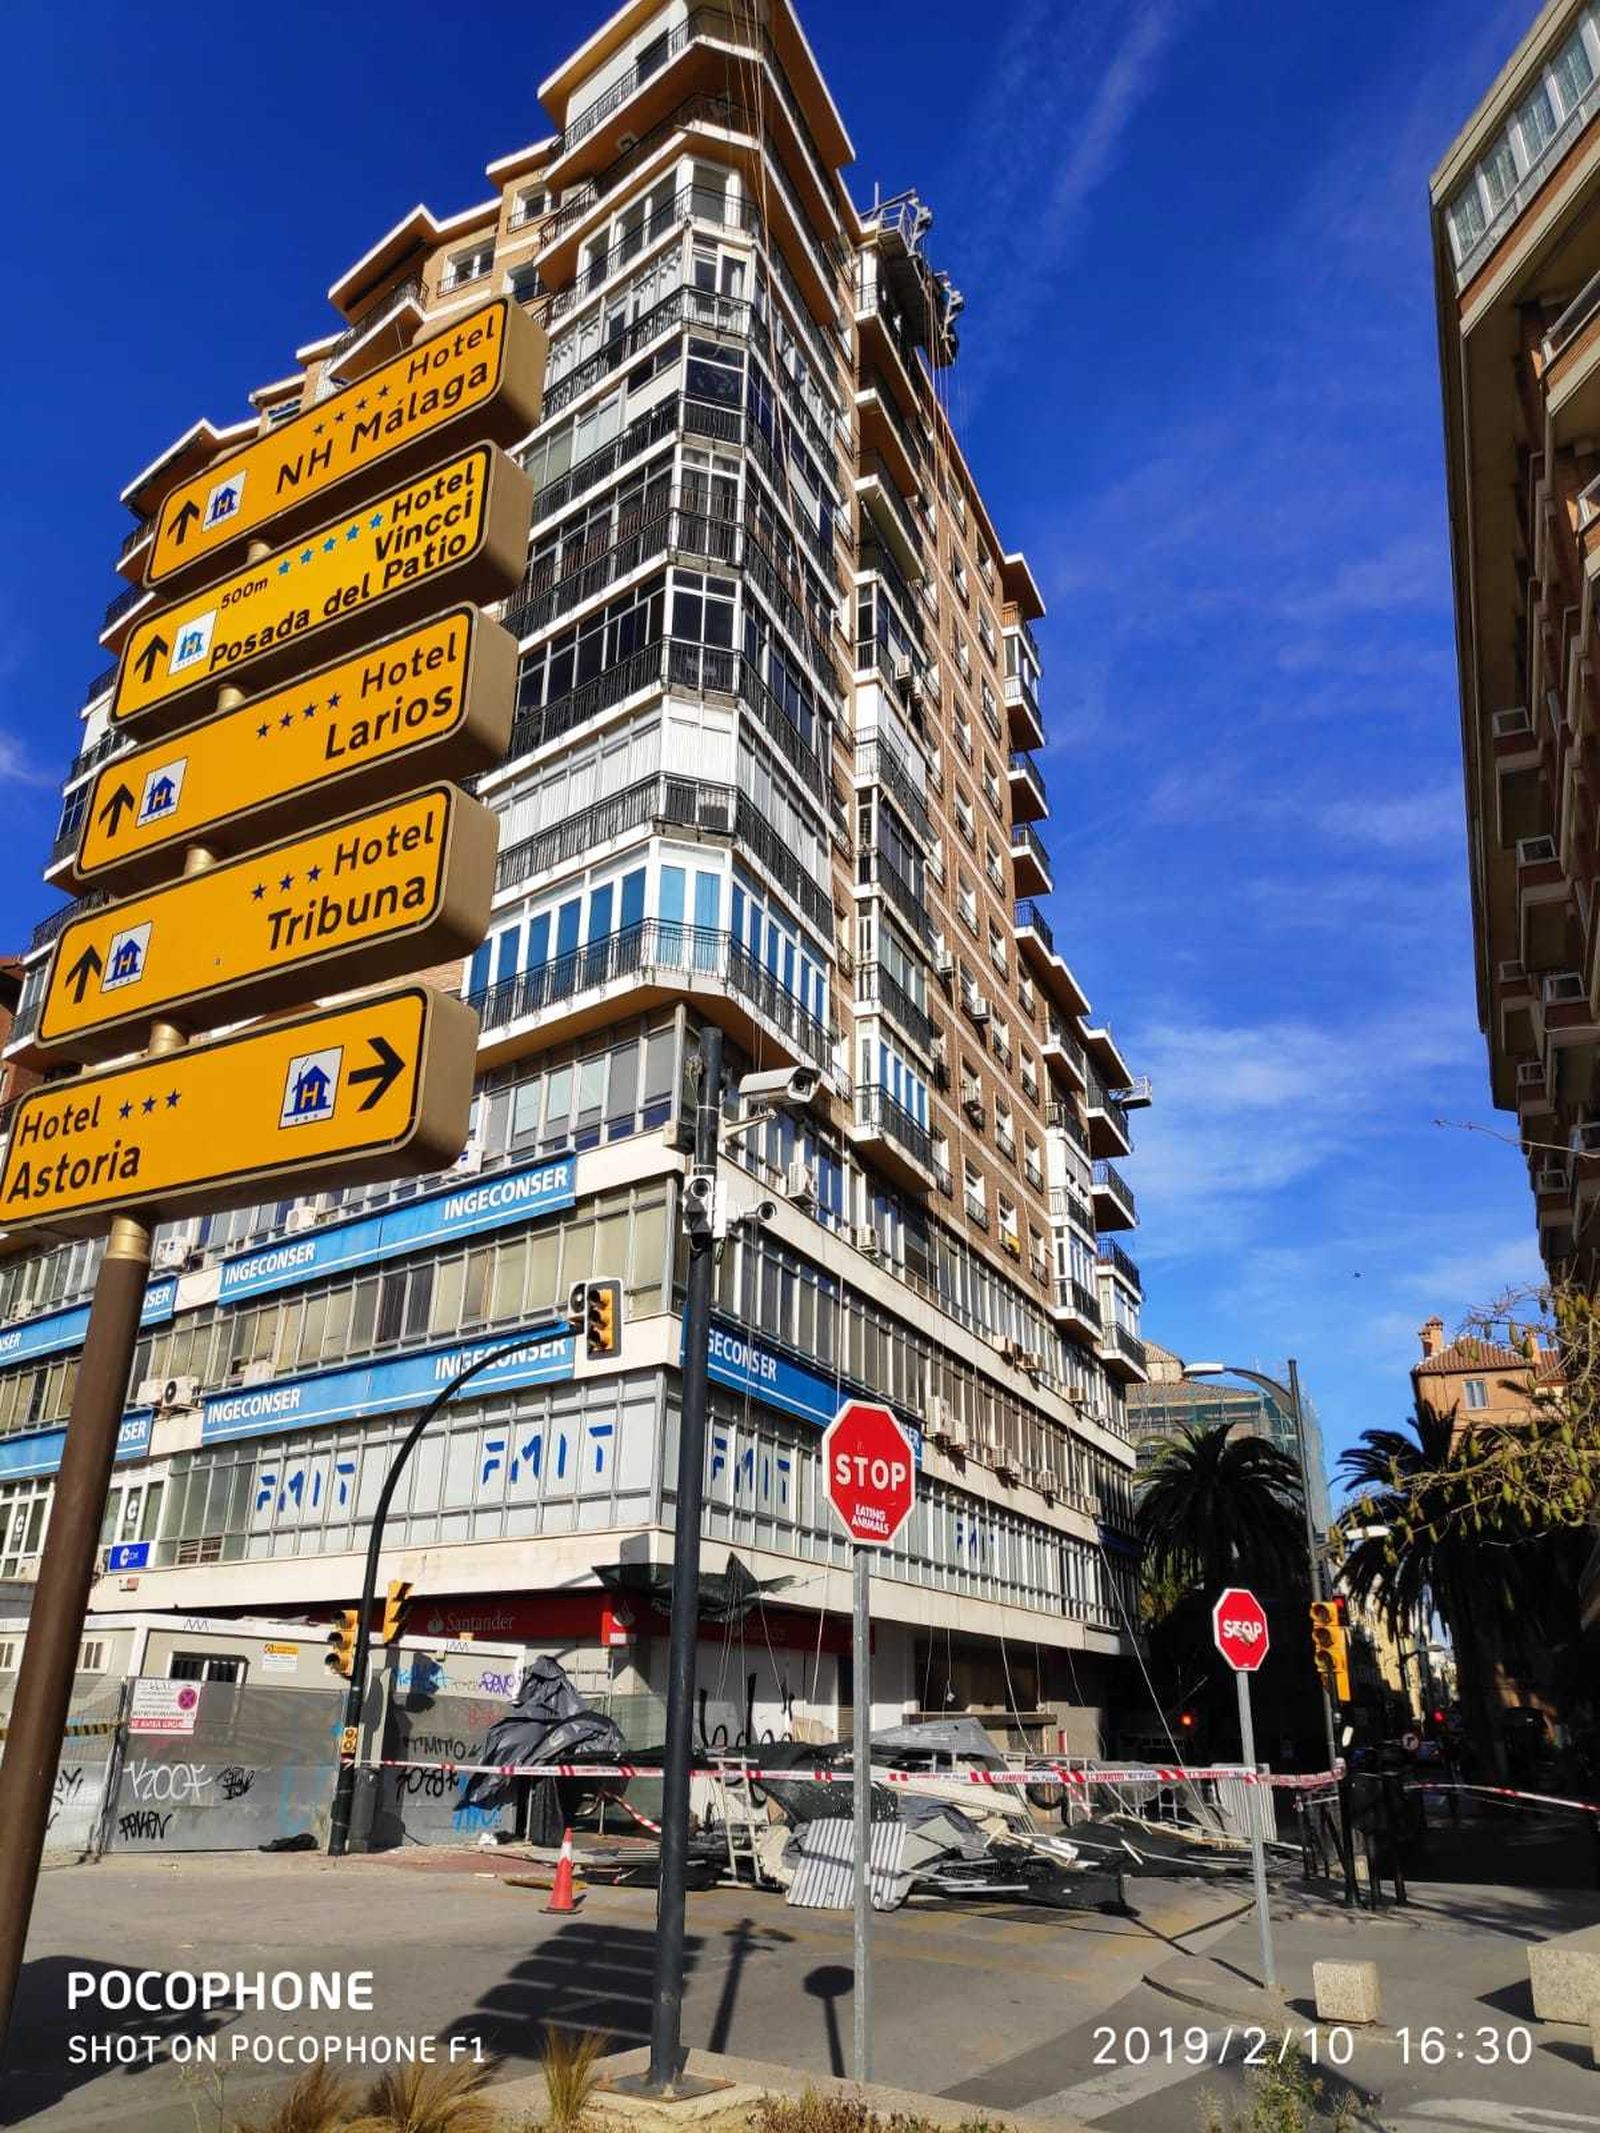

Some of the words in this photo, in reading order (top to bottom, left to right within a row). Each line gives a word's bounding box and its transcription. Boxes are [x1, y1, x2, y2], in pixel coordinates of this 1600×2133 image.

[407, 314, 495, 383] Hotel
[275, 441, 332, 493] NH
[350, 361, 488, 452] Málaga
[391, 461, 475, 523] Hotel
[374, 491, 472, 562] Vincci
[209, 610, 310, 672] Posada
[323, 580, 371, 615] del
[383, 534, 467, 590] Patio
[221, 577, 268, 611] 500m
[361, 632, 457, 699] Hotel
[324, 684, 453, 760] Larios
[334, 811, 434, 876] Hotel
[267, 875, 425, 951] Tribuna
[18, 1094, 101, 1147] Hotel
[8, 1139, 141, 1202] Astoria
[444, 1165, 568, 1220] INGECONSER
[224, 1241, 316, 1287] INGECONSER
[709, 1328, 777, 1383] GECONSER
[207, 1388, 300, 1425] INGECONSER
[835, 1453, 906, 1492] STOP
[851, 1514, 890, 1535] ANIMALS
[855, 1503, 886, 1522] EATING
[446, 1609, 515, 1633] Santander
